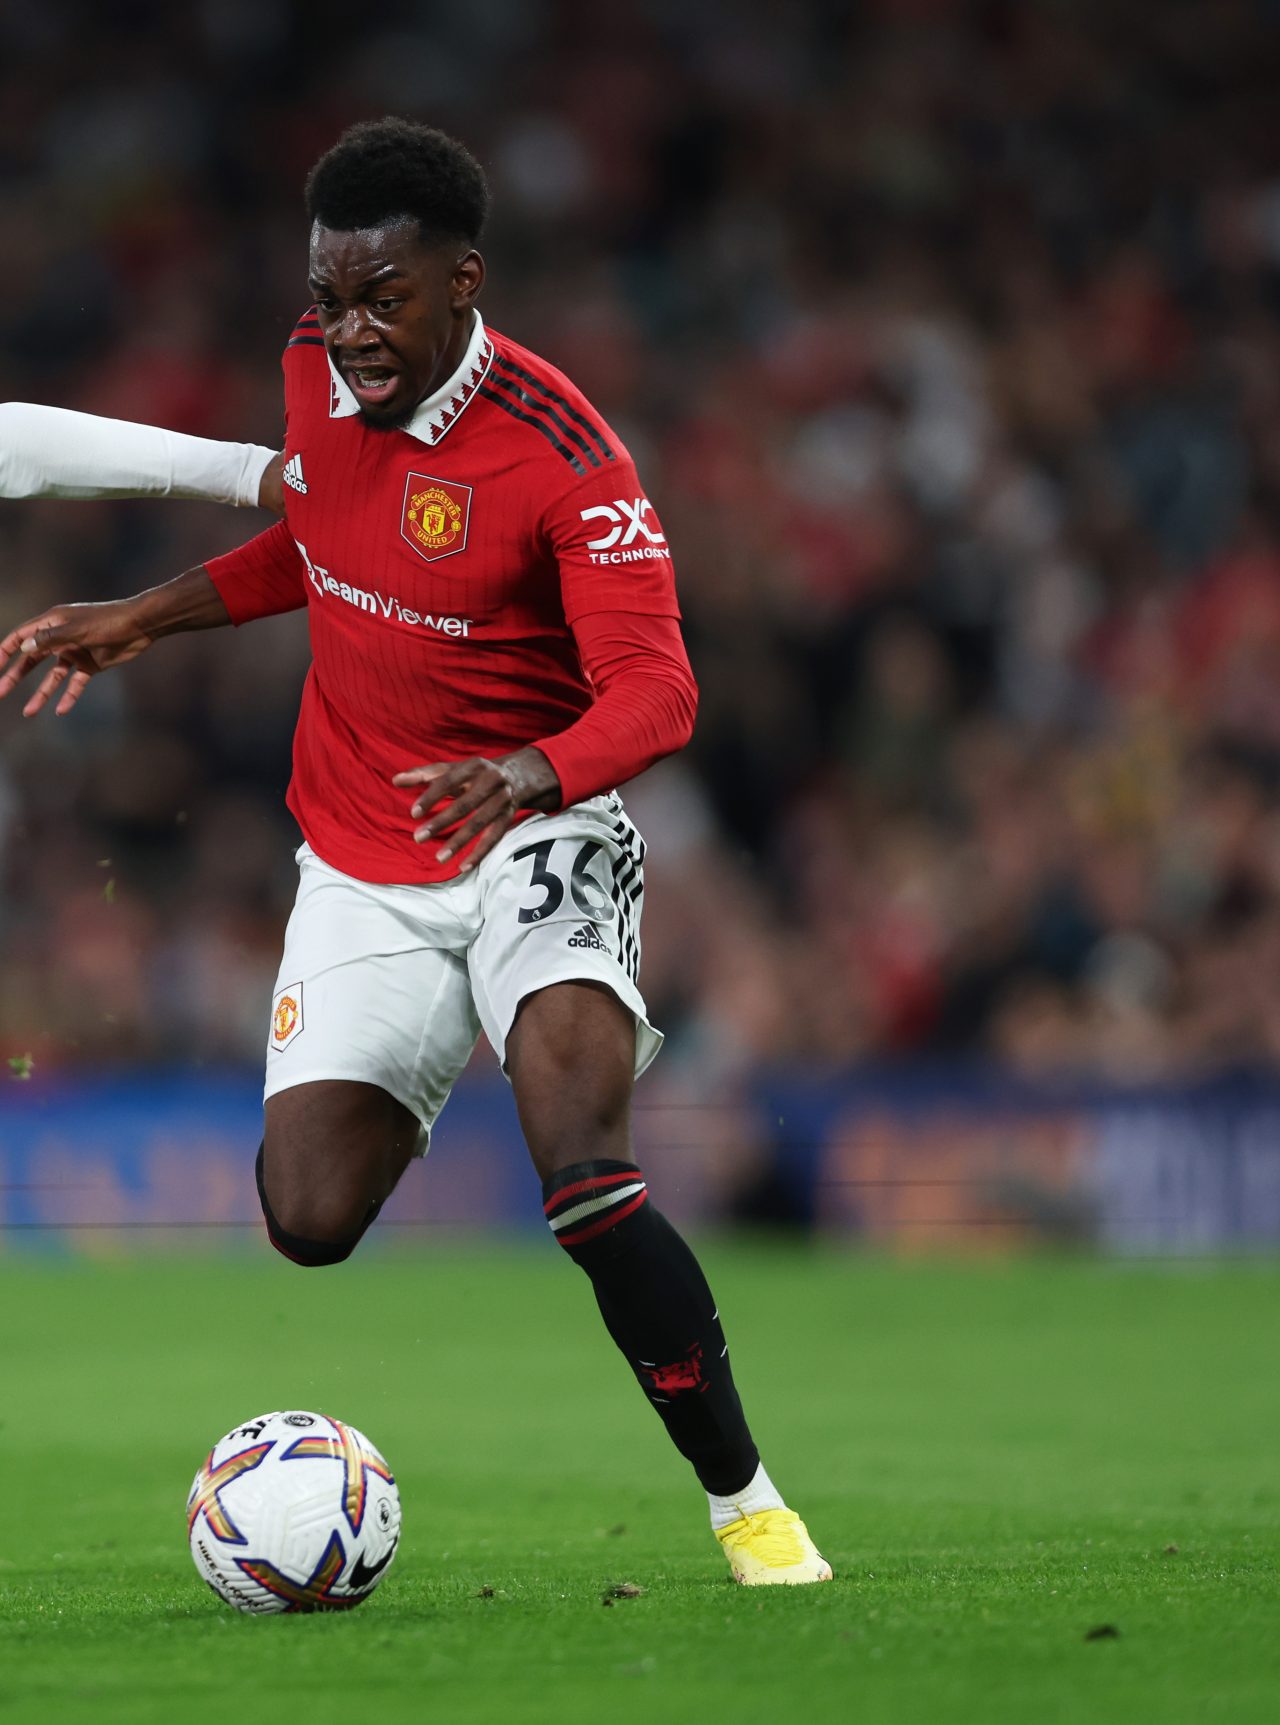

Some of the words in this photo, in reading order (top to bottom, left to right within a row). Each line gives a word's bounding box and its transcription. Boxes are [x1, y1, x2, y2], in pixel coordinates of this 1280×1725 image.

[414, 491, 457, 517] MANCHESTER
[417, 530, 448, 545] UNITED
[580, 497, 667, 550] DXC
[313, 563, 474, 638] TeamViewer
[513, 838, 616, 925] 36
[567, 937, 613, 957] adidas
[197, 1540, 218, 1571] NIKE
